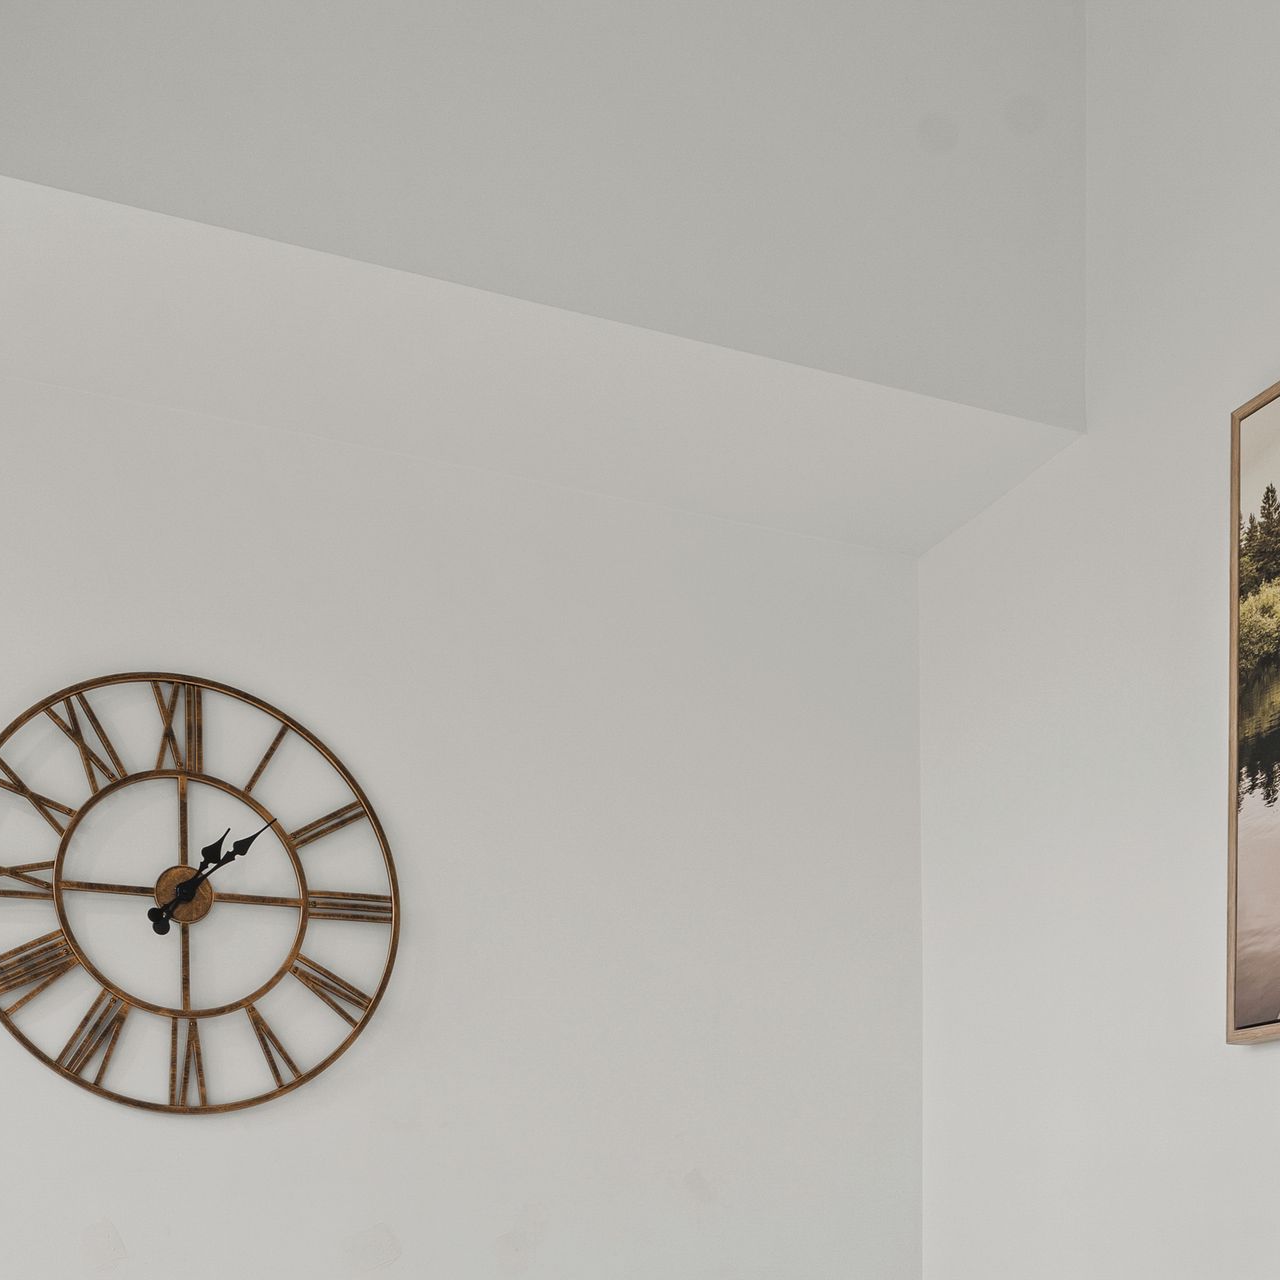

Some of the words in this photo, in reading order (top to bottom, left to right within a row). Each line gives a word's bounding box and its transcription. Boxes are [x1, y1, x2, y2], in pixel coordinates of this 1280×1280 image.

[43, 691, 128, 795] XI
[151, 679, 204, 773] XII
[244, 724, 289, 793] I
[287, 801, 369, 849] II
[308, 890, 394, 924] III
[287, 953, 374, 1027] IV
[55, 989, 129, 1086] VII
[169, 1016, 207, 1106] VI
[245, 1003, 303, 1088] V
